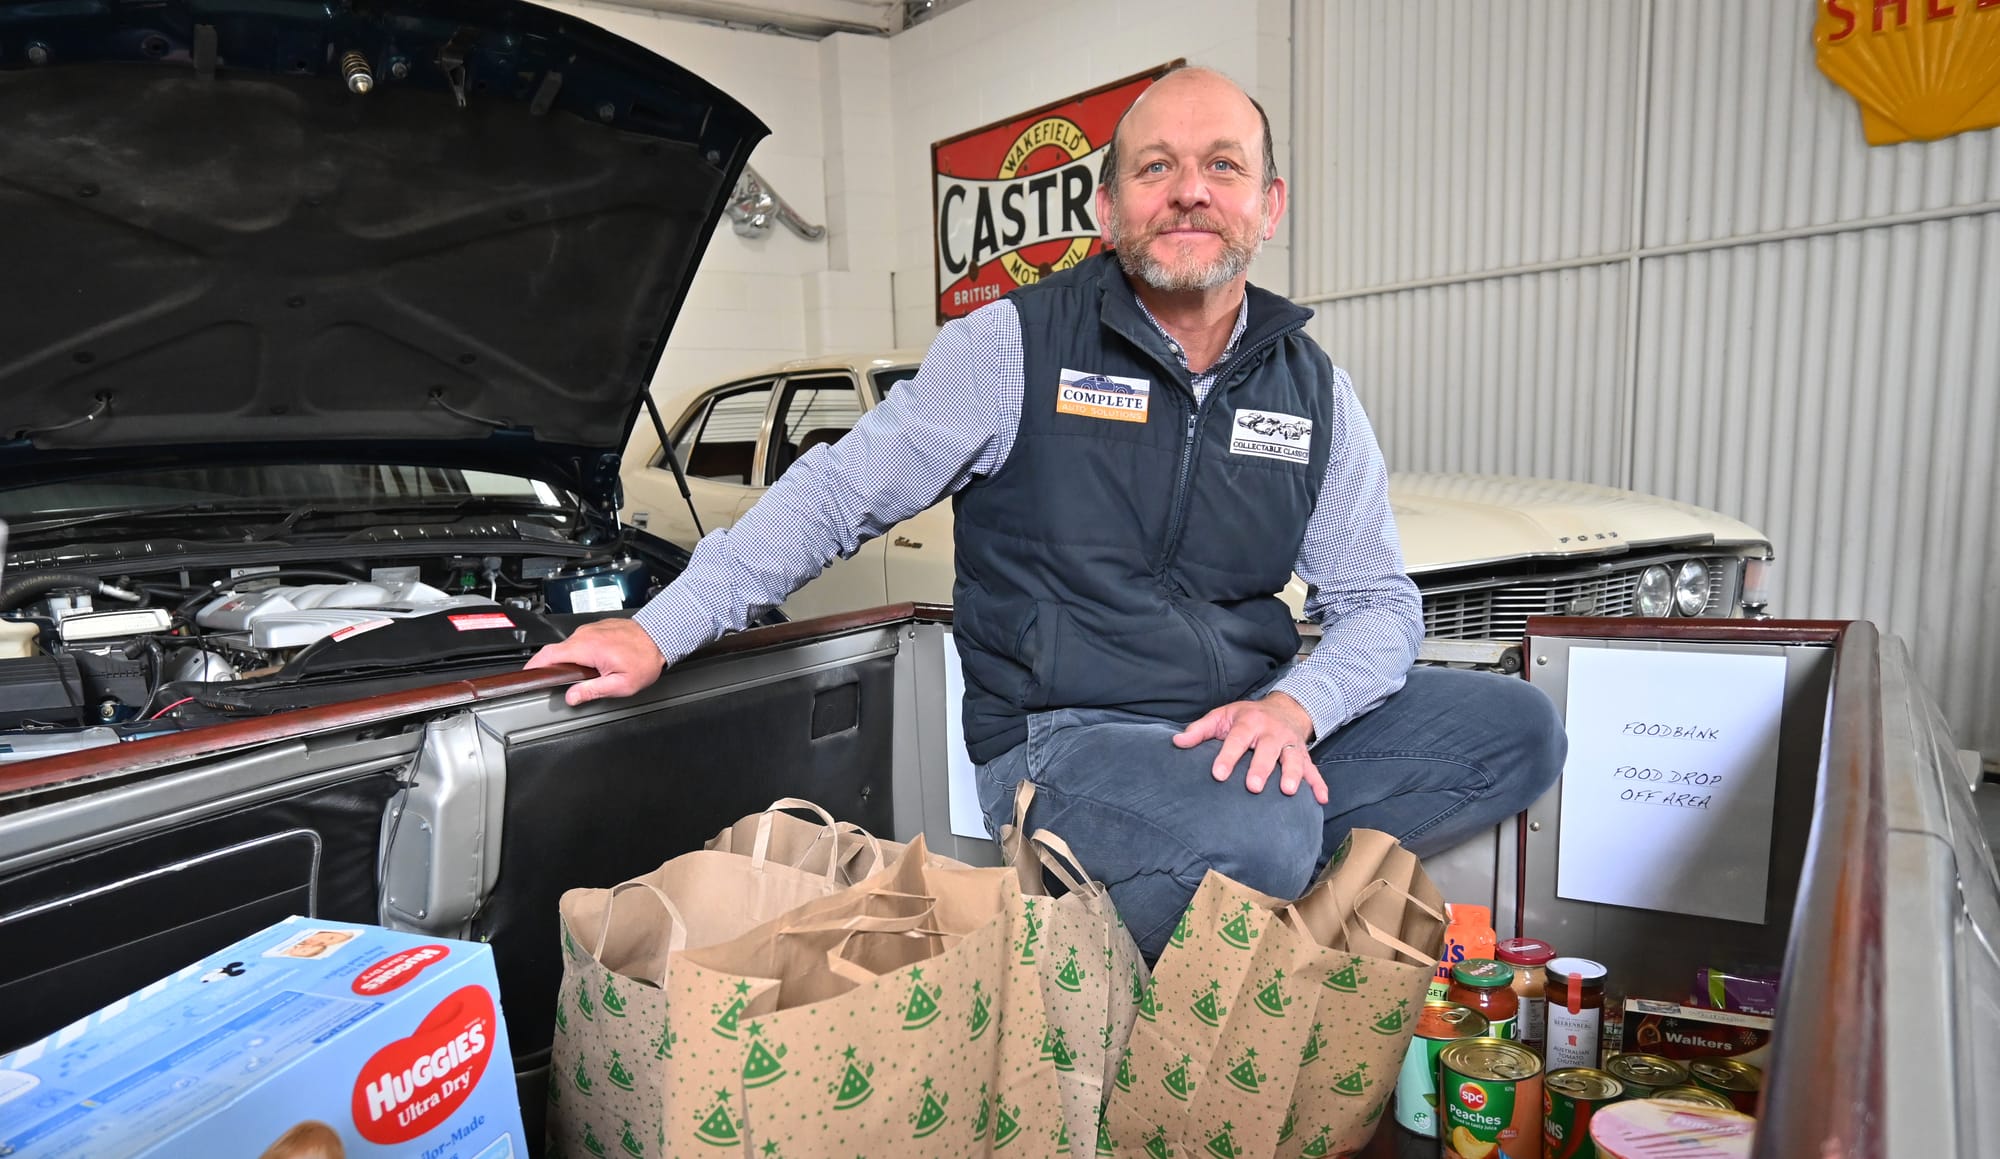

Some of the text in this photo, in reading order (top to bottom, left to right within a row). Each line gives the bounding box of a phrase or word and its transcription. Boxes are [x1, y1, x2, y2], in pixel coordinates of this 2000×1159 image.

[1004, 122, 1081, 172] WAKEFIELD
[940, 164, 1097, 274] CASTR
[1010, 258, 1040, 285] MOT
[954, 283, 1000, 306] BRITISH
[1063, 389, 1143, 409] COMPLETE
[1232, 441, 1282, 454] COLLECTABLE
[1621, 722, 1720, 740] FOODBANK
[1613, 765, 1722, 786] FOOD DROP
[1620, 789, 1712, 809] OFF AREA
[1665, 1031, 1733, 1051] Walkers
[365, 1022, 486, 1122] HUGGIES
[398, 1069, 472, 1127] Ultra Dry
[1461, 1090, 1484, 1104] spc
[1449, 1103, 1502, 1126] Peaches
